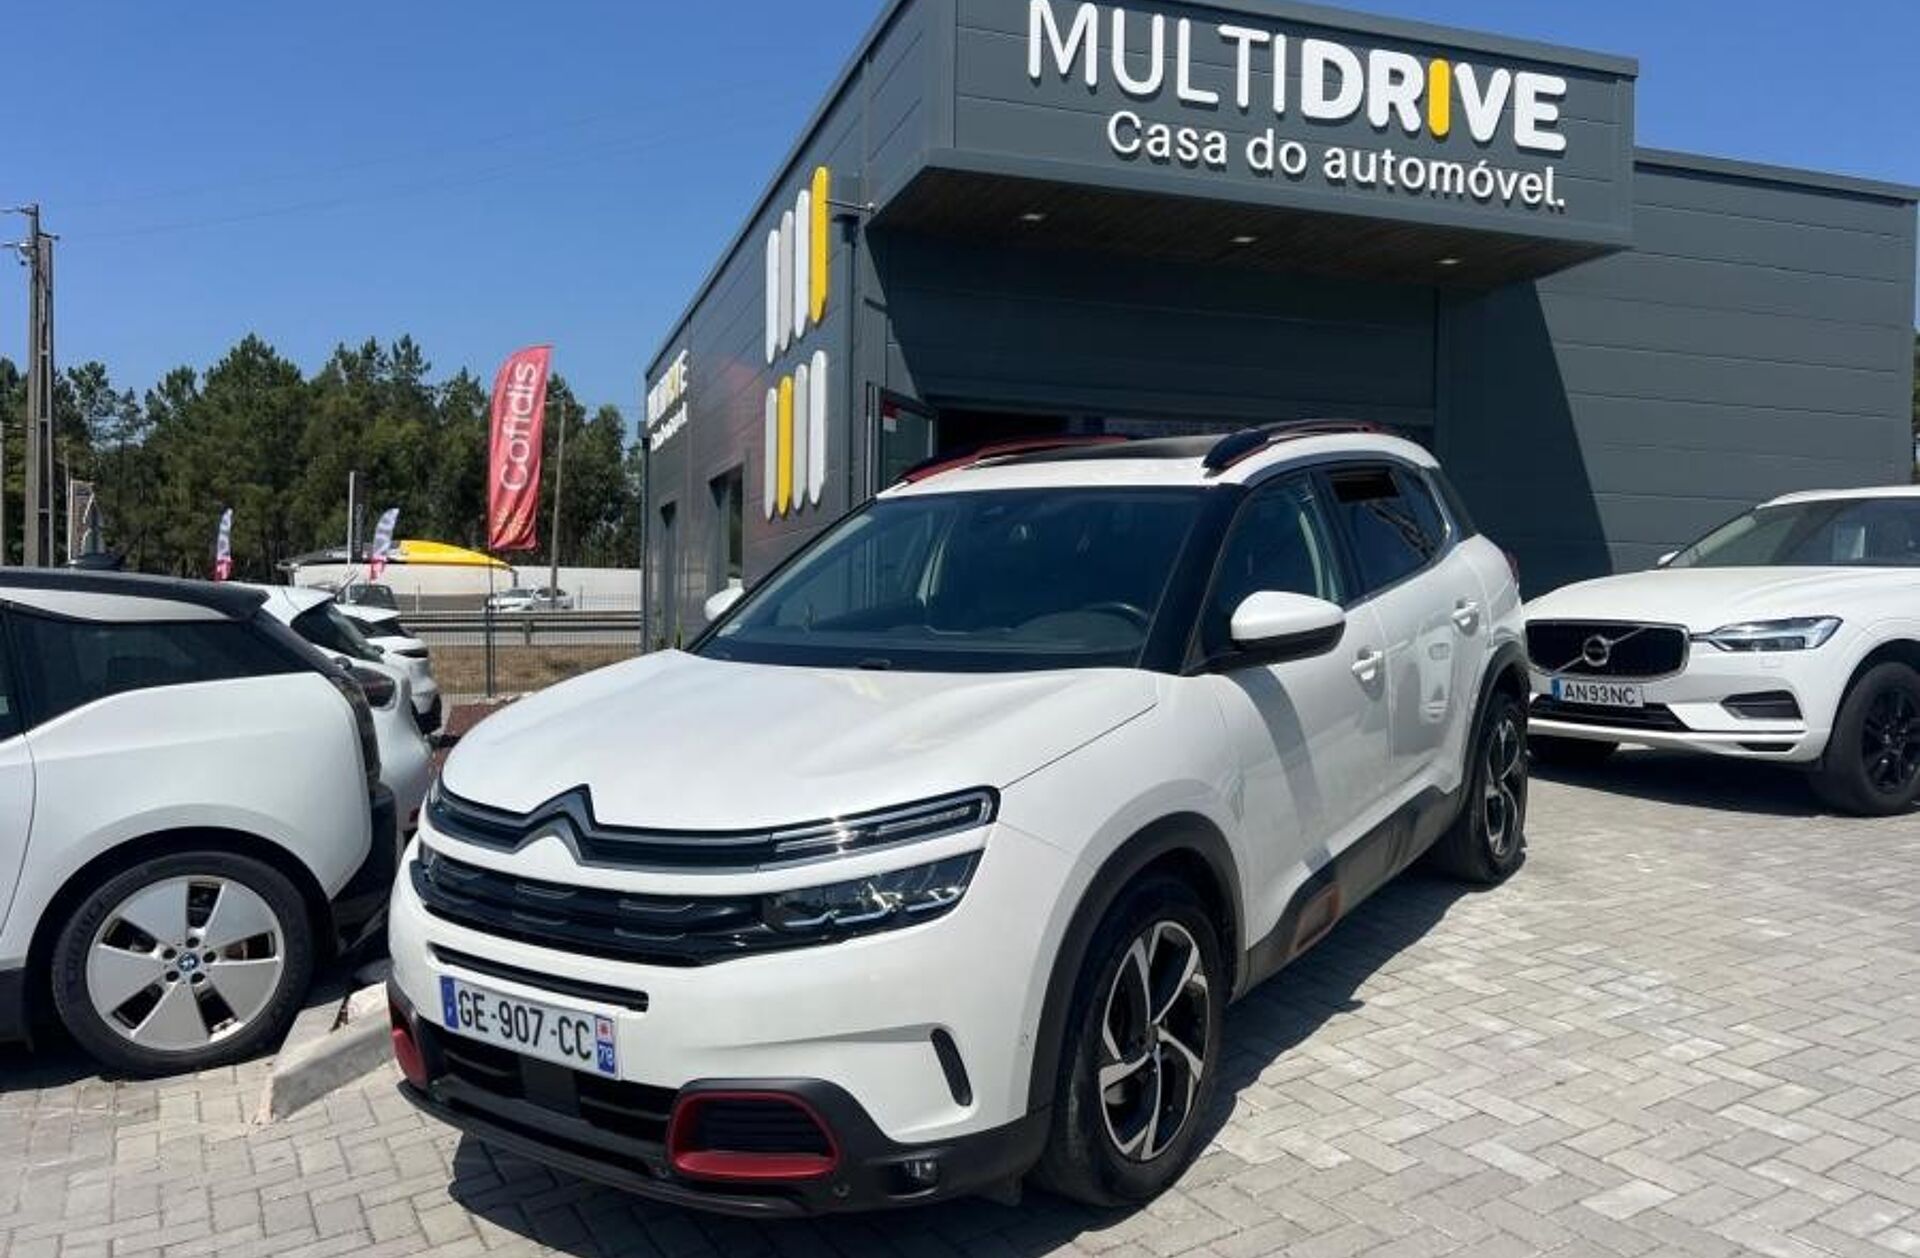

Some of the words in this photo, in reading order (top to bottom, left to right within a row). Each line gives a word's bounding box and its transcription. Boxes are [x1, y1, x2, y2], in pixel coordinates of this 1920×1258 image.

[1028, 0, 1567, 152] MULTIDRIVE
[1107, 111, 1227, 164] Casa
[1246, 128, 1307, 175] do
[1323, 147, 1566, 207] automóvel.
[501, 362, 537, 491] Cofidis
[1564, 683, 1635, 704] AN93NC
